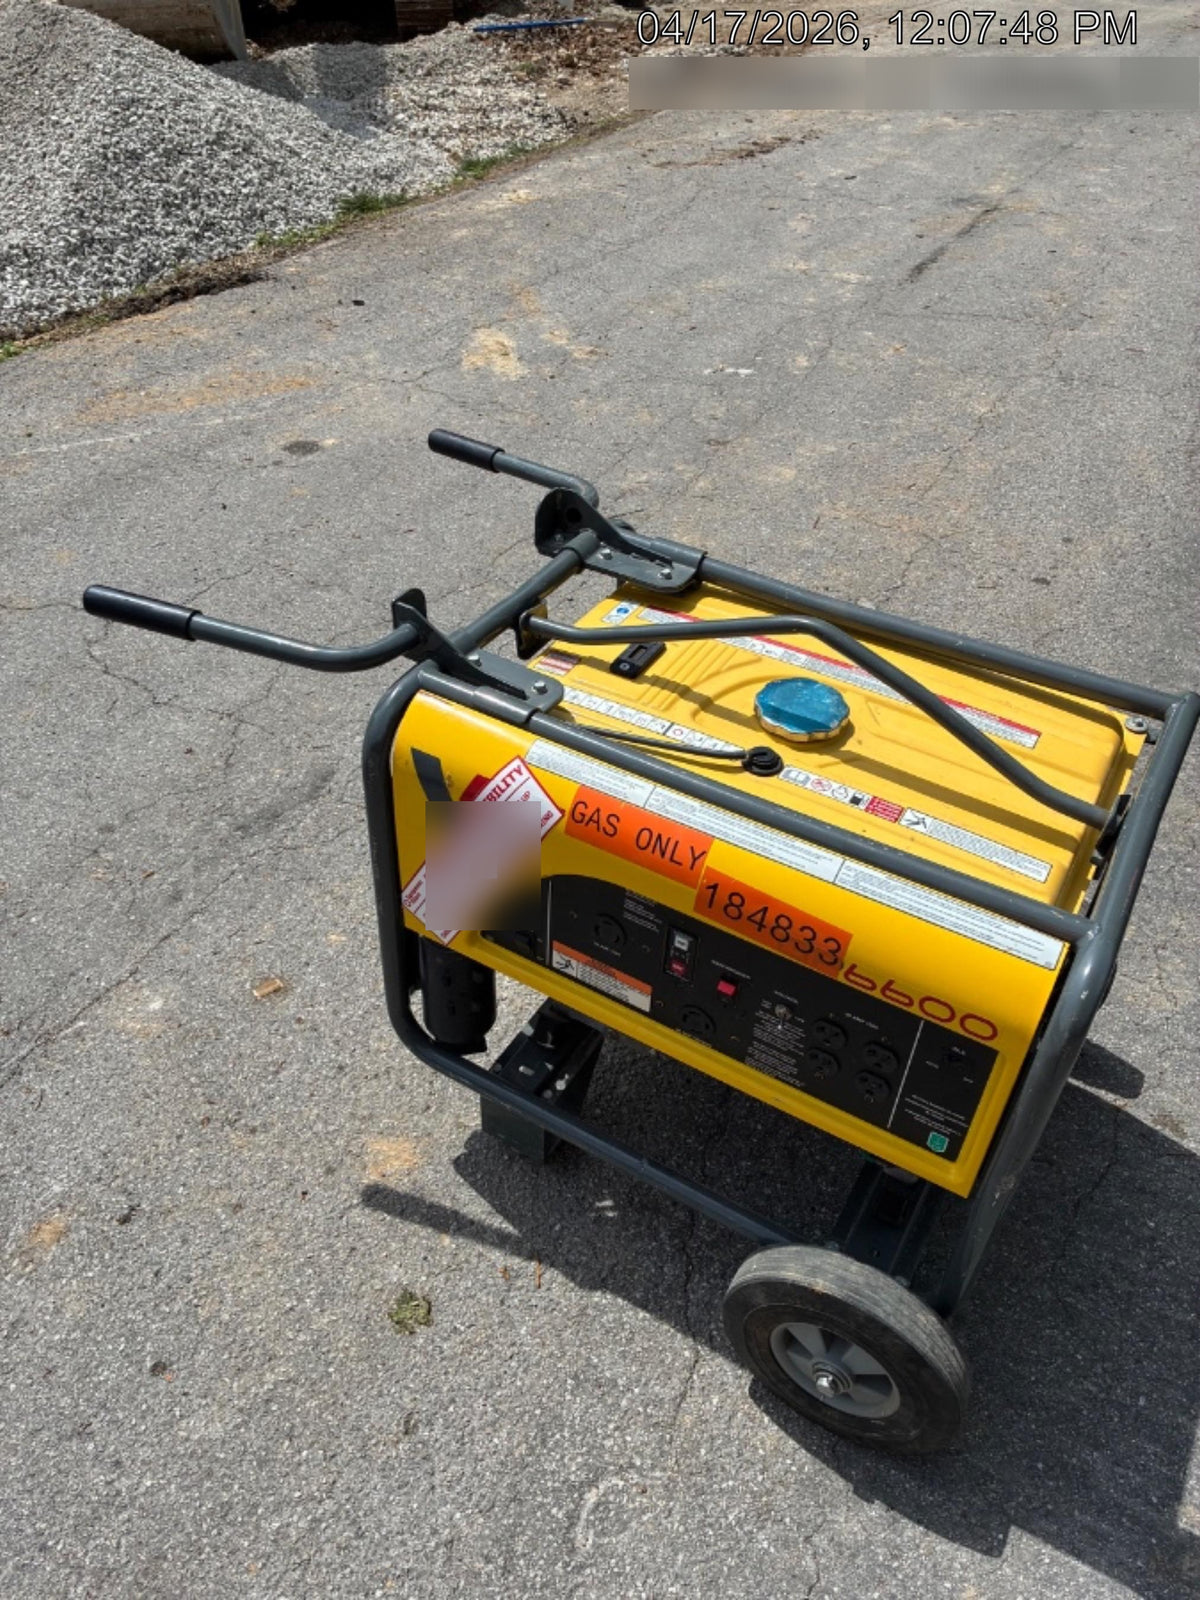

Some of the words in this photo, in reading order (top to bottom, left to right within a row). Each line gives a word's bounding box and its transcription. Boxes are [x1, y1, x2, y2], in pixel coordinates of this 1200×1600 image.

[483, 765, 523, 801] BILITY
[571, 801, 621, 838] GAS
[635, 828, 707, 871] ONLY
[705, 882, 841, 967] 184833
[844, 963, 998, 1042] 6600
